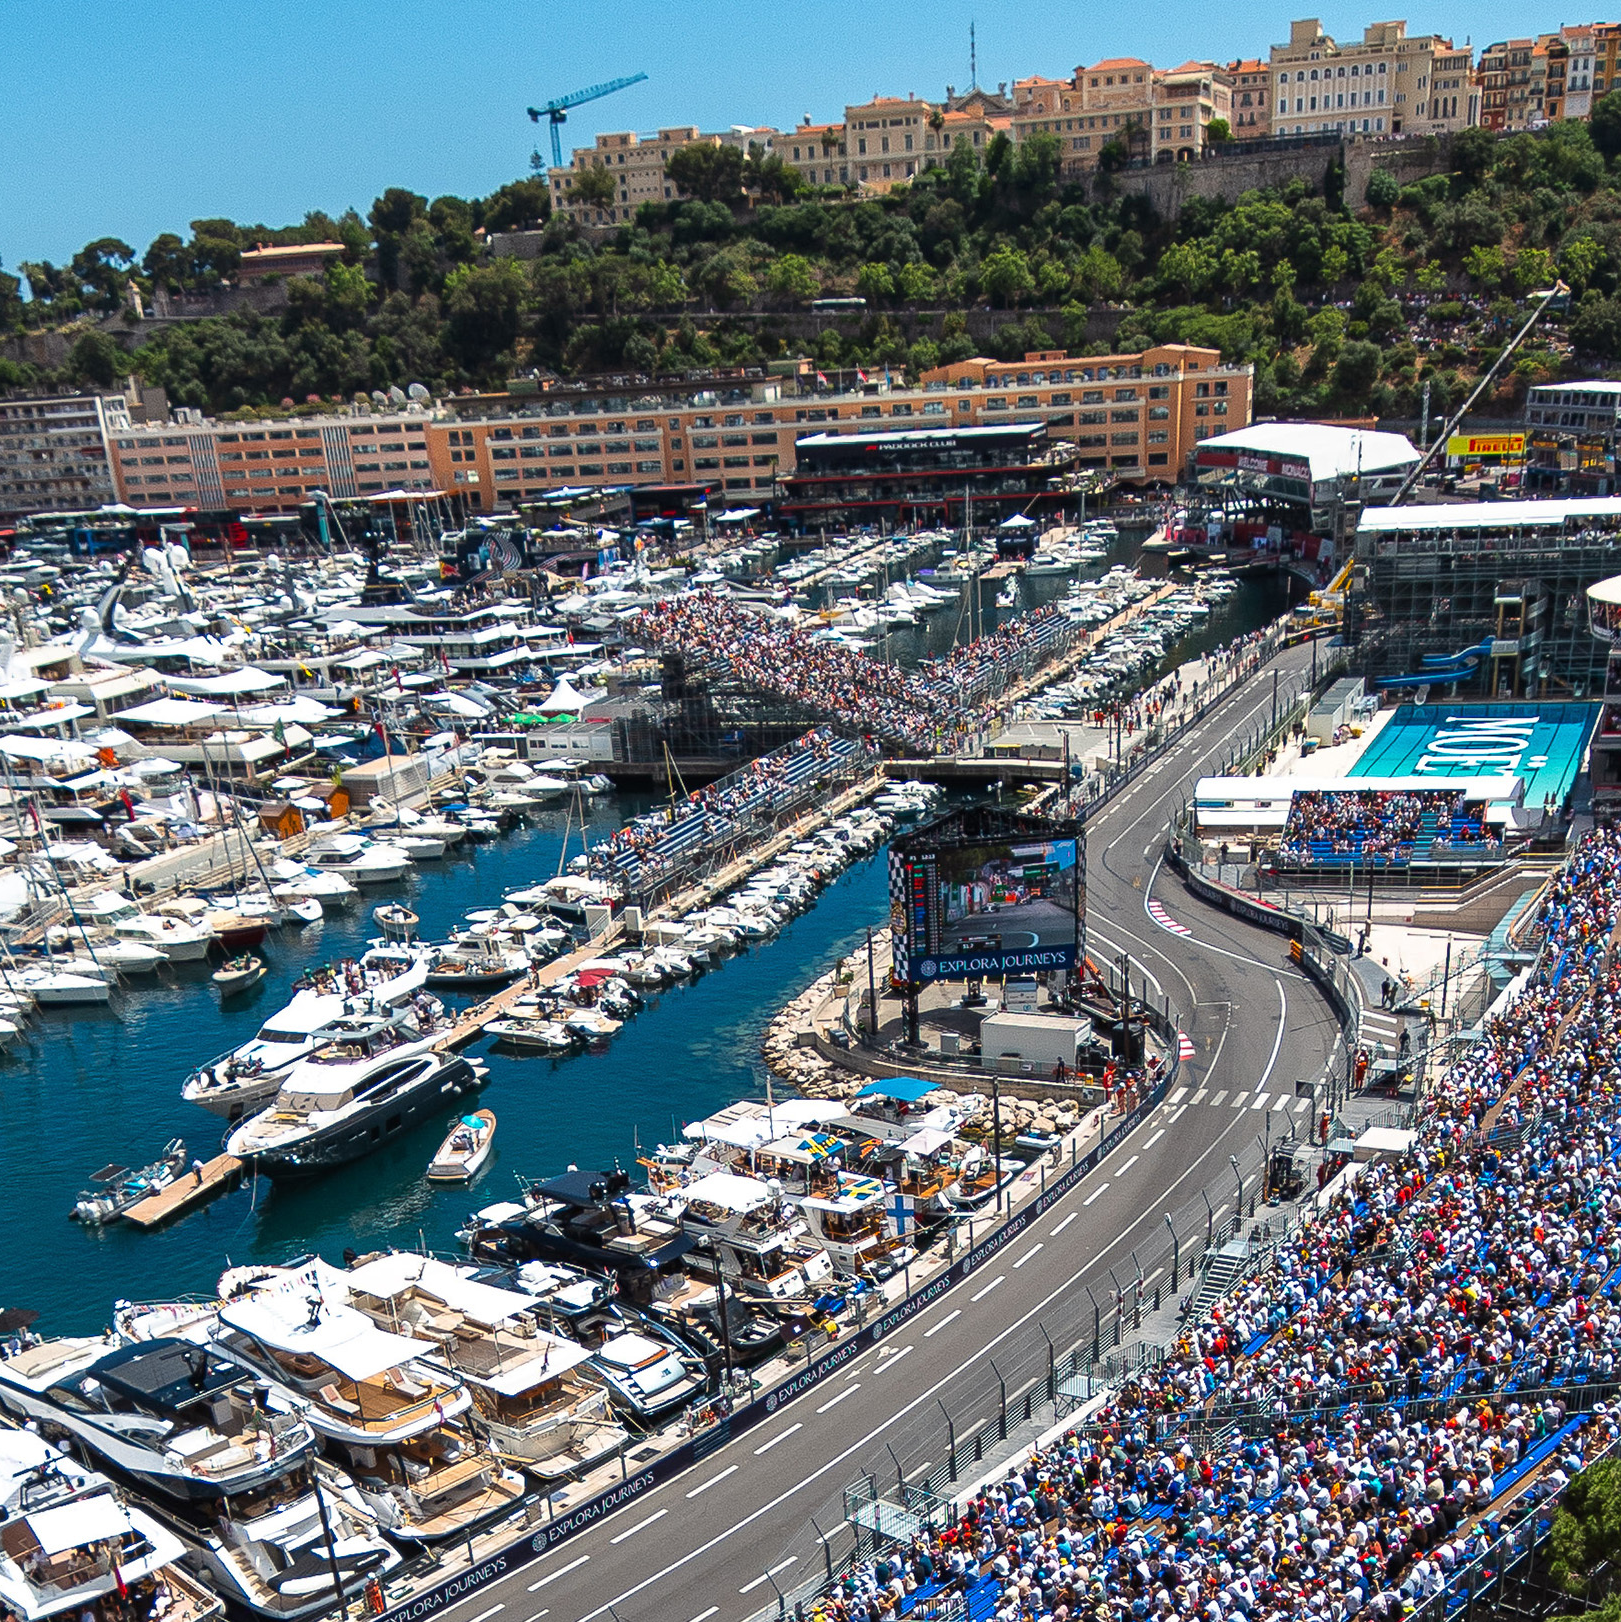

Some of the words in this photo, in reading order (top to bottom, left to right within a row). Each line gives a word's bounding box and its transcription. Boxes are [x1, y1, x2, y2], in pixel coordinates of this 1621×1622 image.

[879, 441, 928, 450] PADDOCK
[930, 439, 957, 448] CLUB
[1238, 455, 1268, 472] WELCOME
[1281, 463, 1310, 480] MONACO
[939, 957, 999, 973] EXPLORA
[1001, 951, 1066, 970] JOURNEYS
[970, 1238, 997, 1266] EXPLORA
[995, 1213, 1027, 1244] JOURNEYS
[882, 1301, 915, 1331] EXPLORA
[912, 1274, 950, 1309] JOURNEYS
[778, 1368, 817, 1402] EXPLORA
[817, 1340, 858, 1378] JOURNEYS
[547, 1503, 600, 1542] EXPLORA
[601, 1470, 655, 1514] JOURNEYS
[444, 1555, 508, 1603] JOURNEYS
